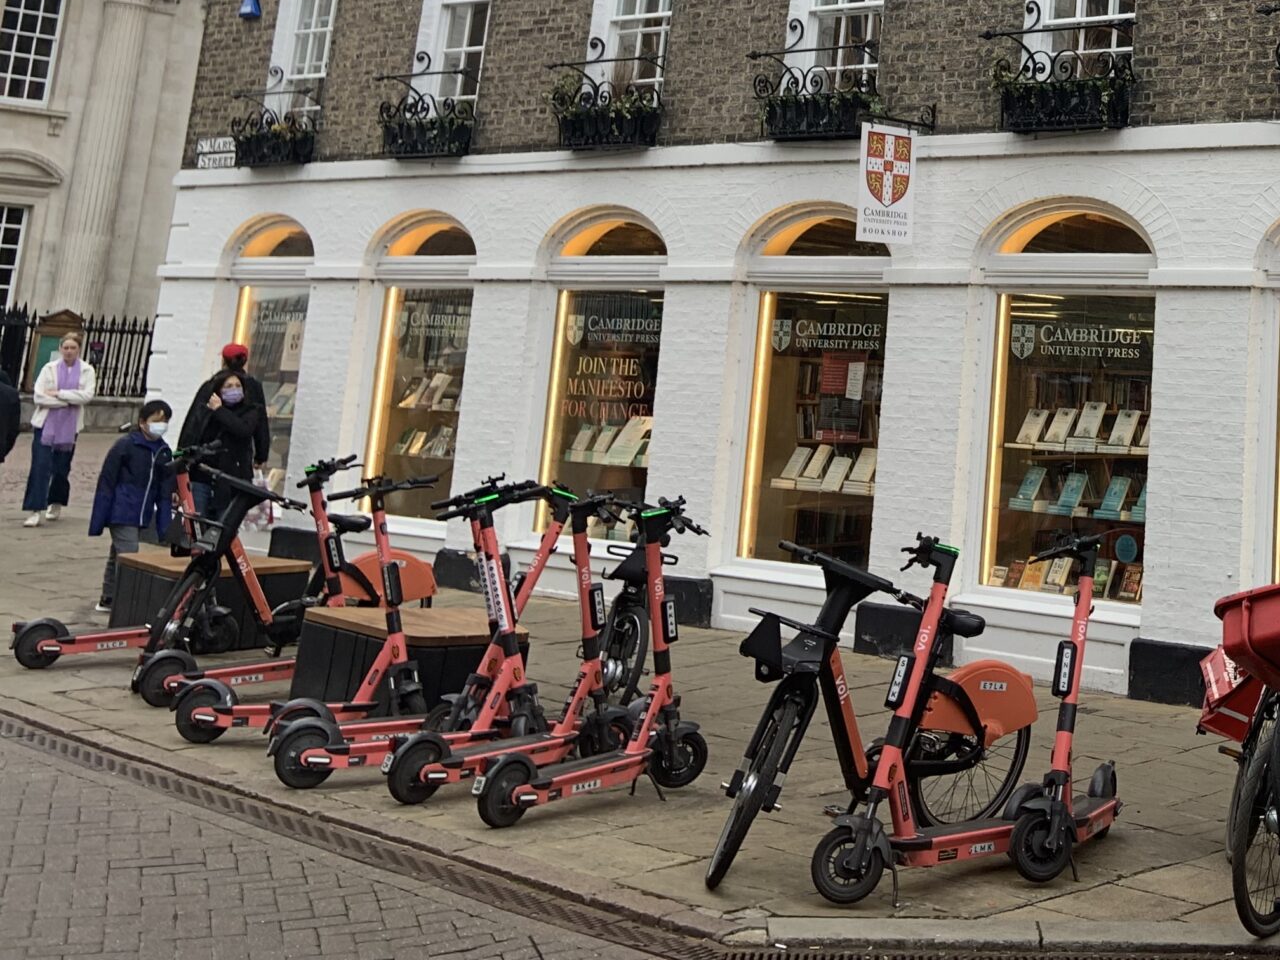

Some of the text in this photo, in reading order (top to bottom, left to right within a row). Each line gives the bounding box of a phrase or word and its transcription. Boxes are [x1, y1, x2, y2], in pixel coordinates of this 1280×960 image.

[200, 155, 235, 168] STREET
[863, 207, 908, 220] CAMBRIDGE
[863, 218, 892, 226] UNIVERSITY
[862, 227, 908, 238] BOOKSHOP
[588, 315, 661, 332] CAMBRIDGE
[795, 319, 881, 338] CAMBRIDGE
[587, 332, 660, 344] UNIVERSITY PRESS
[1040, 325, 1142, 345] CAMBRIDGE
[795, 338, 880, 351] UNIVERSITY PRESS
[1040, 345, 1141, 359] UNIVERSITY PRESS
[576, 356, 640, 377] JOIN THE
[567, 378, 646, 399] MANIFESTO
[561, 400, 649, 421] FOR CHANGE
